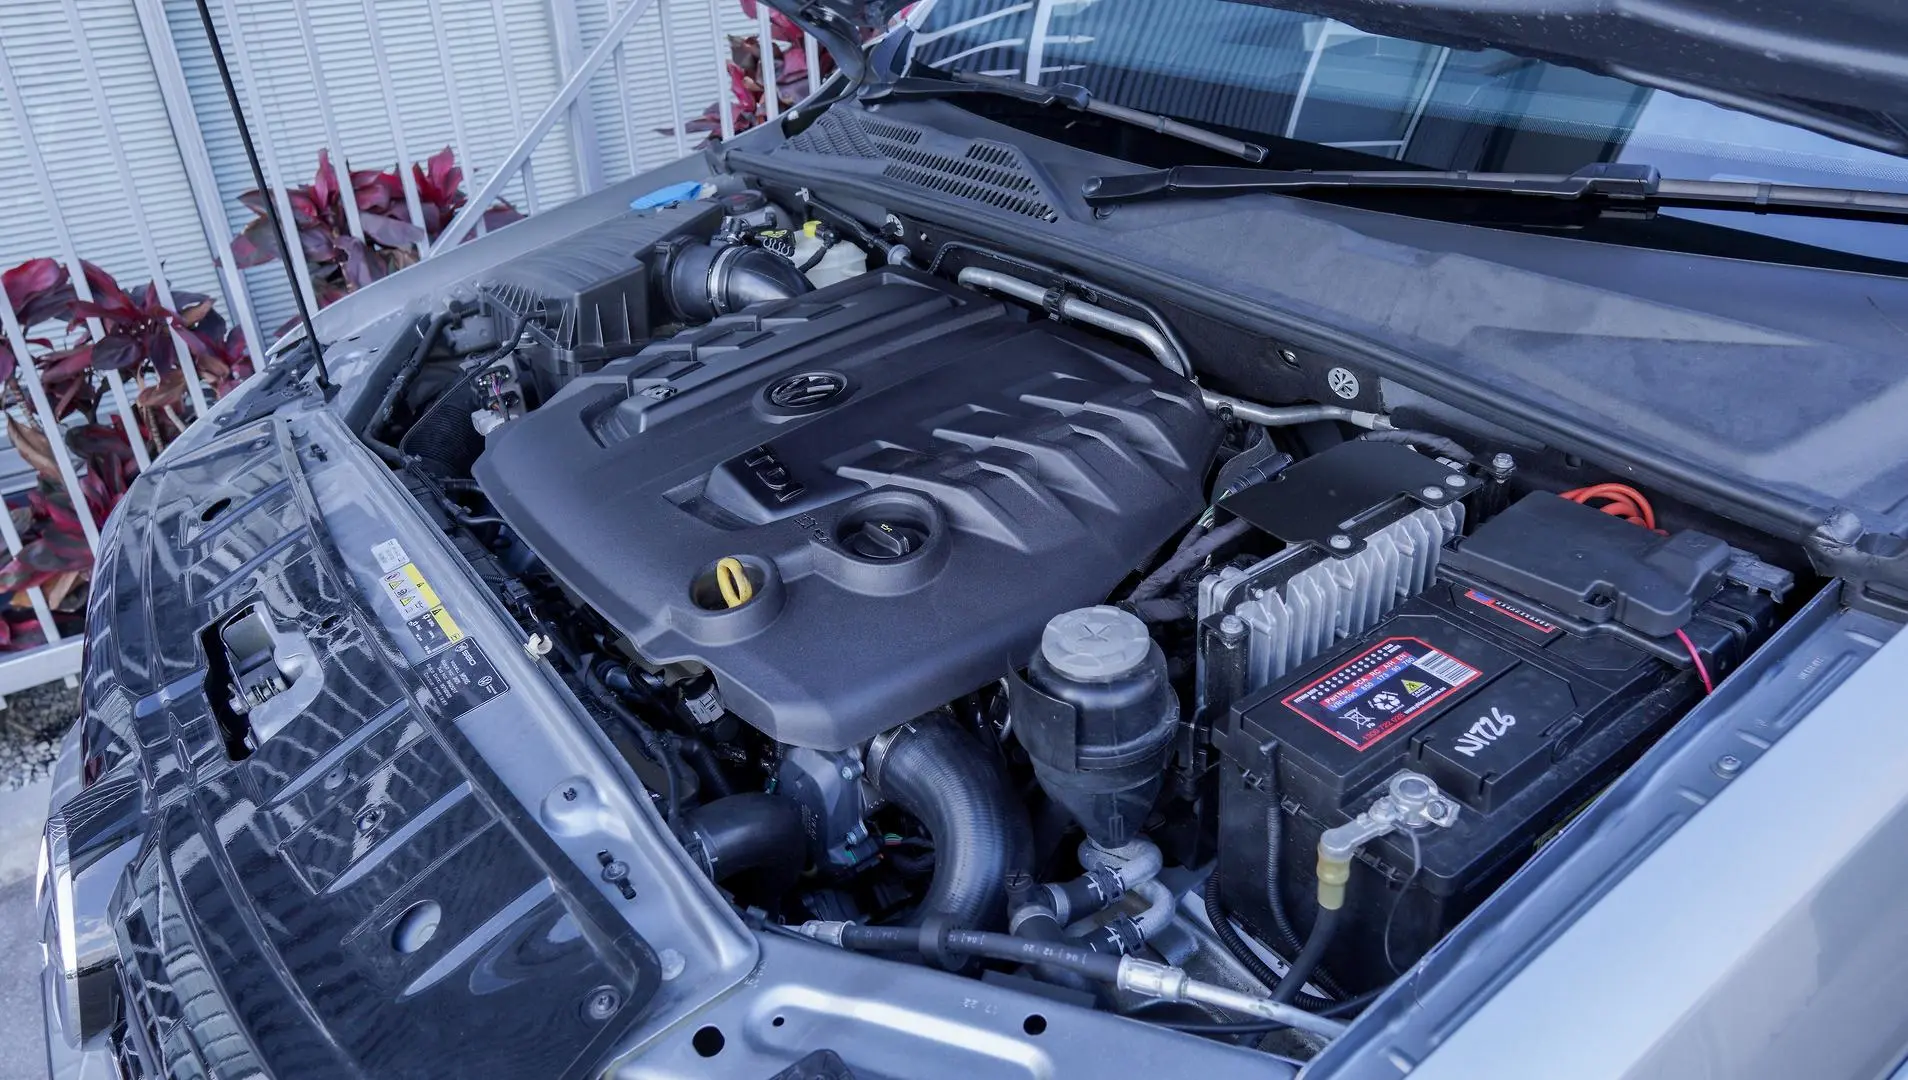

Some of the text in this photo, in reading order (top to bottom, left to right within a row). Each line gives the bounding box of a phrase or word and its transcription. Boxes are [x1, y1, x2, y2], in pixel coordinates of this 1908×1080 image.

[744, 445, 807, 502] TDI
[1352, 677, 1369, 688] CCA
[1369, 668, 1381, 677] RC
[1376, 672, 1389, 681] 173
